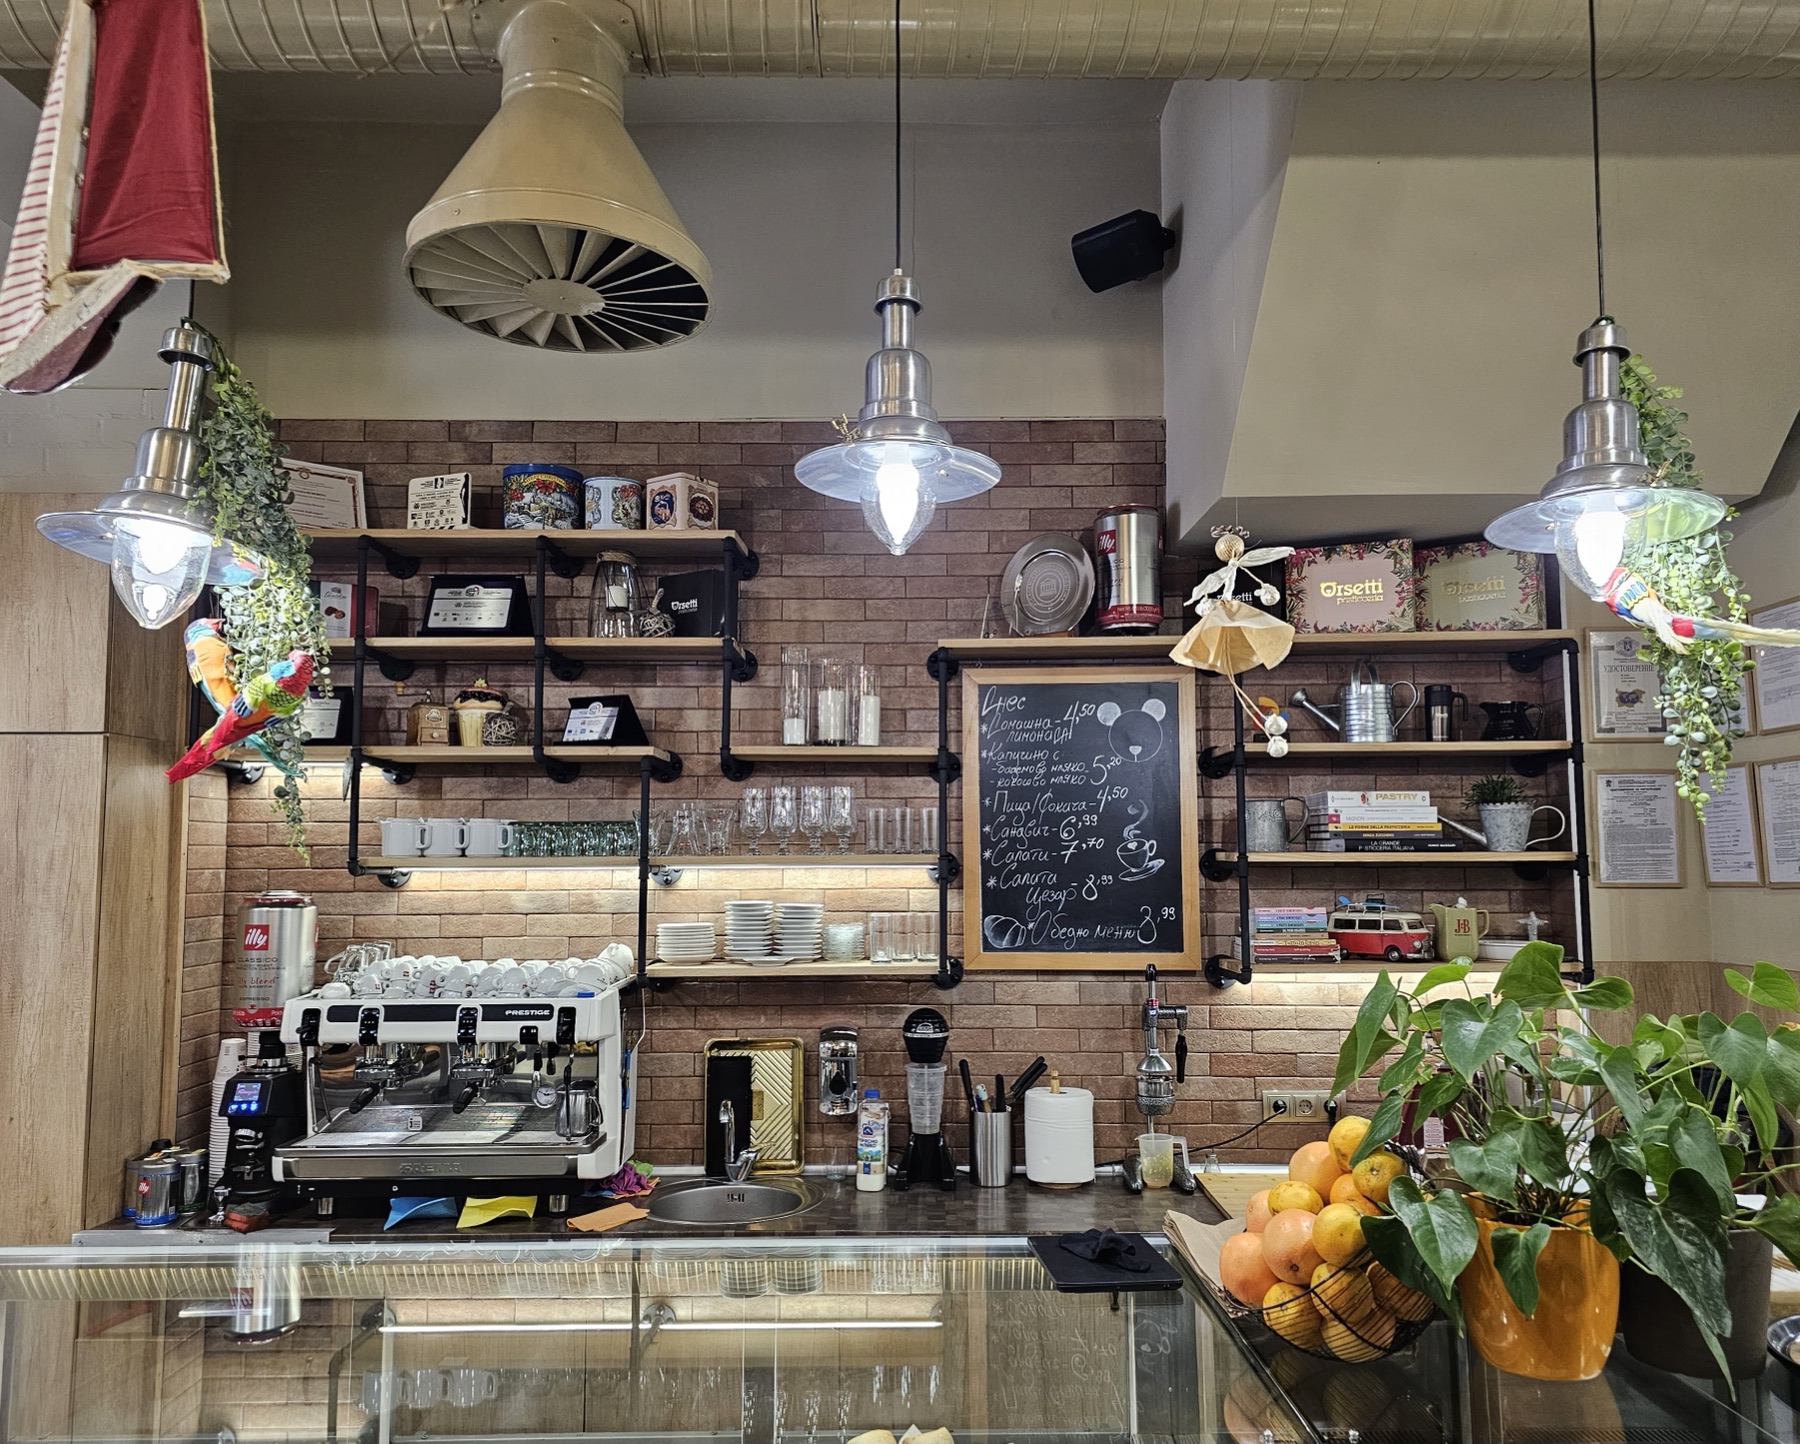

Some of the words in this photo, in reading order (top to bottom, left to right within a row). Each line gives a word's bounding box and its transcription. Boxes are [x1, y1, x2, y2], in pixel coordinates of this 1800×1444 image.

[1320, 578, 1383, 598] Orsetti
[1441, 576, 1506, 596] Orsetti
[671, 598, 698, 611] Orsetti
[981, 686, 1026, 716] Днес
[1097, 786, 1128, 813] 4,50
[1375, 793, 1418, 801] PASTRY
[245, 928, 268, 949] illy
[138, 1182, 150, 1194] illy
